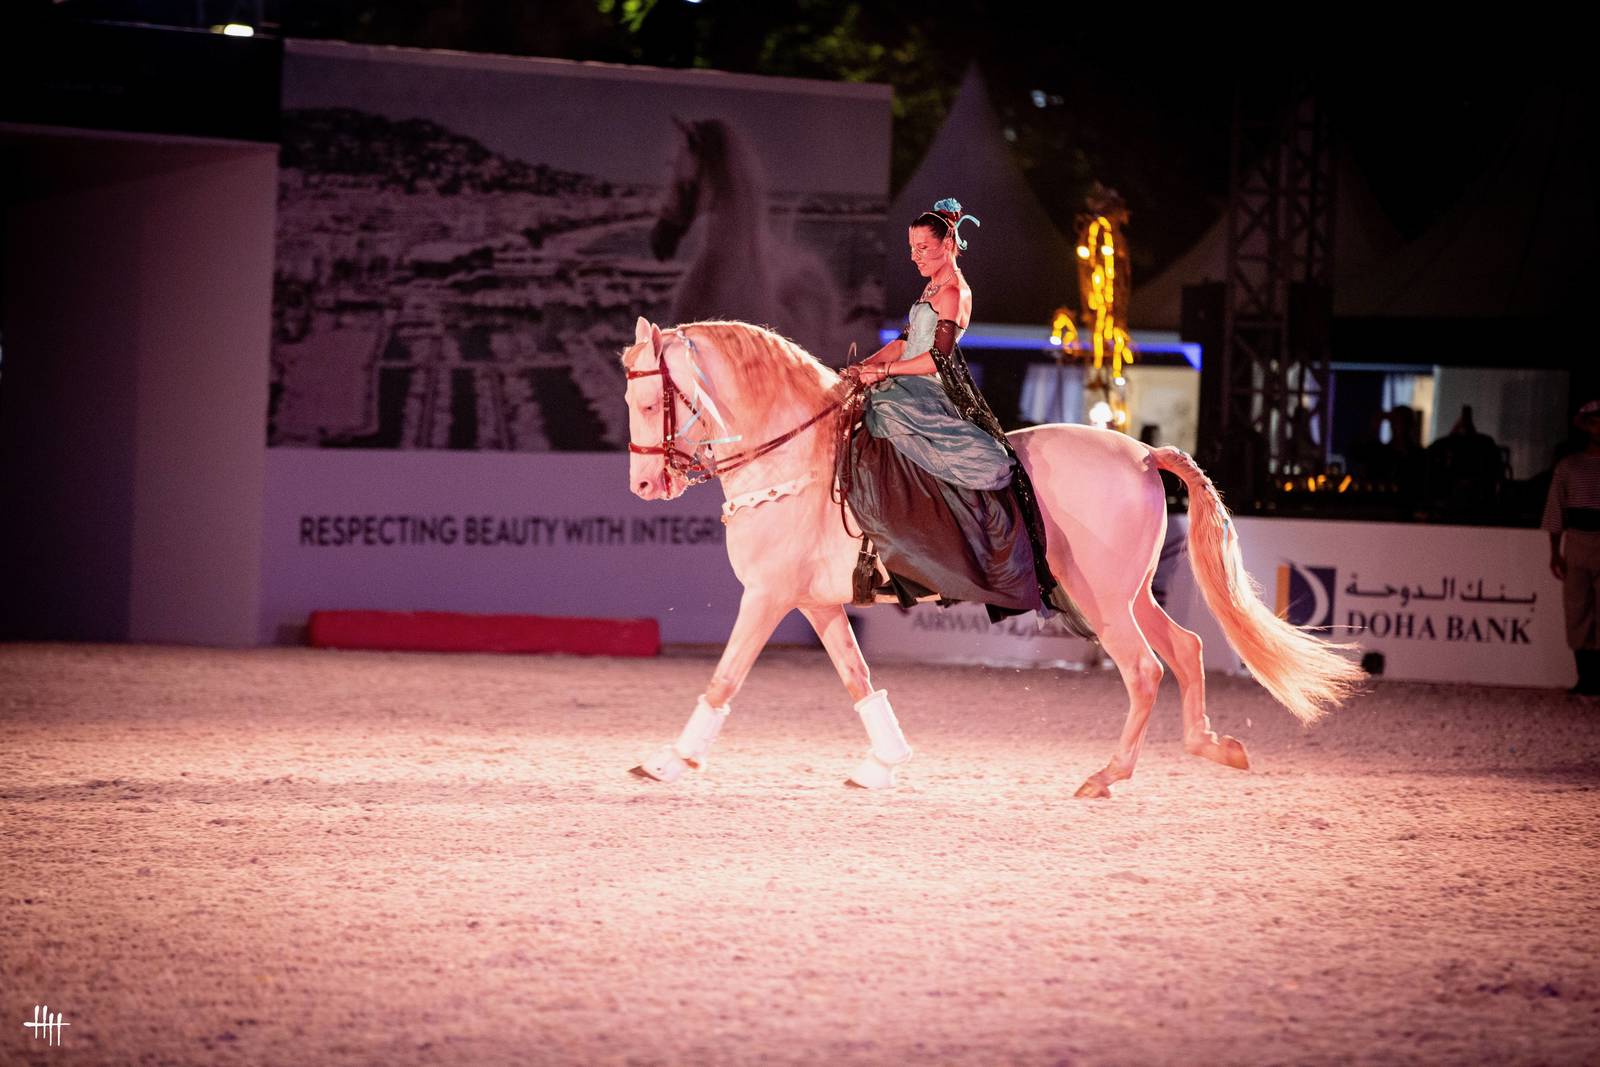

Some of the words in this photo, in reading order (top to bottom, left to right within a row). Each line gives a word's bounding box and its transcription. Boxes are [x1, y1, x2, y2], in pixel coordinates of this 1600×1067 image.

[299, 515, 458, 547] RESPECTING
[463, 515, 557, 547] BEAUTY
[563, 516, 626, 547] WITH
[1346, 572, 1456, 606] الدوحة
[1460, 578, 1537, 612] بنك
[1347, 610, 1438, 640] DOHA
[1445, 615, 1533, 645] BANK
